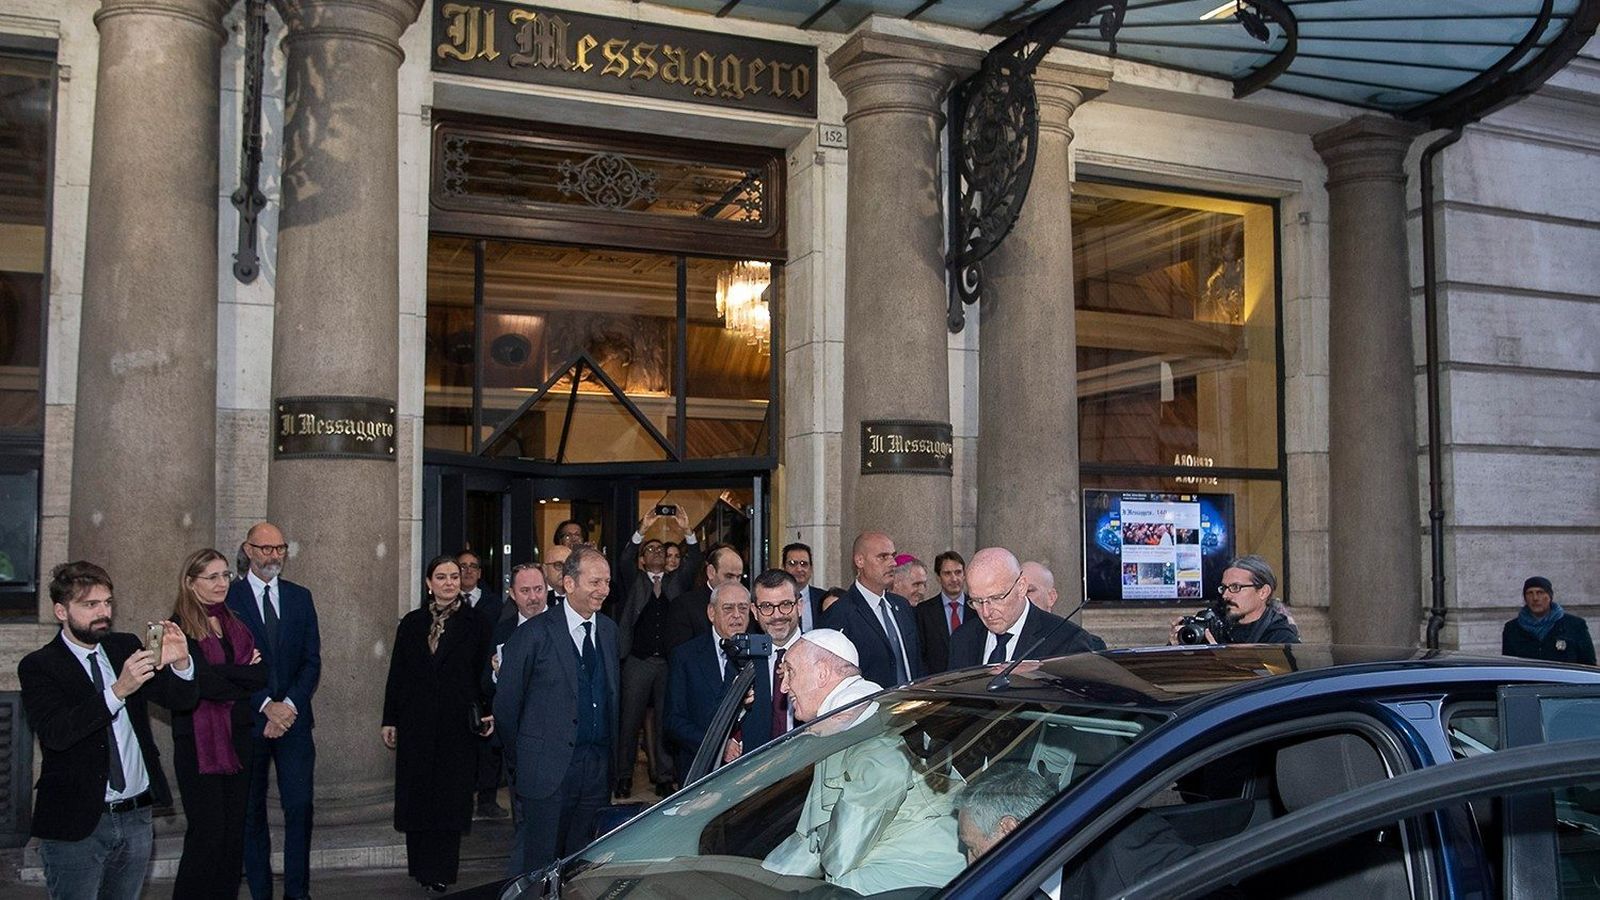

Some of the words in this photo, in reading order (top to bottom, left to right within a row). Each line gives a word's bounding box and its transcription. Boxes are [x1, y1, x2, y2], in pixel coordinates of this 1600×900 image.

[437, 3, 500, 62] Il
[508, 8, 812, 99] Messaggero
[825, 130, 843, 143] 152
[281, 414, 295, 436] Il
[298, 413, 394, 442] Messaggero
[869, 434, 885, 454] Il
